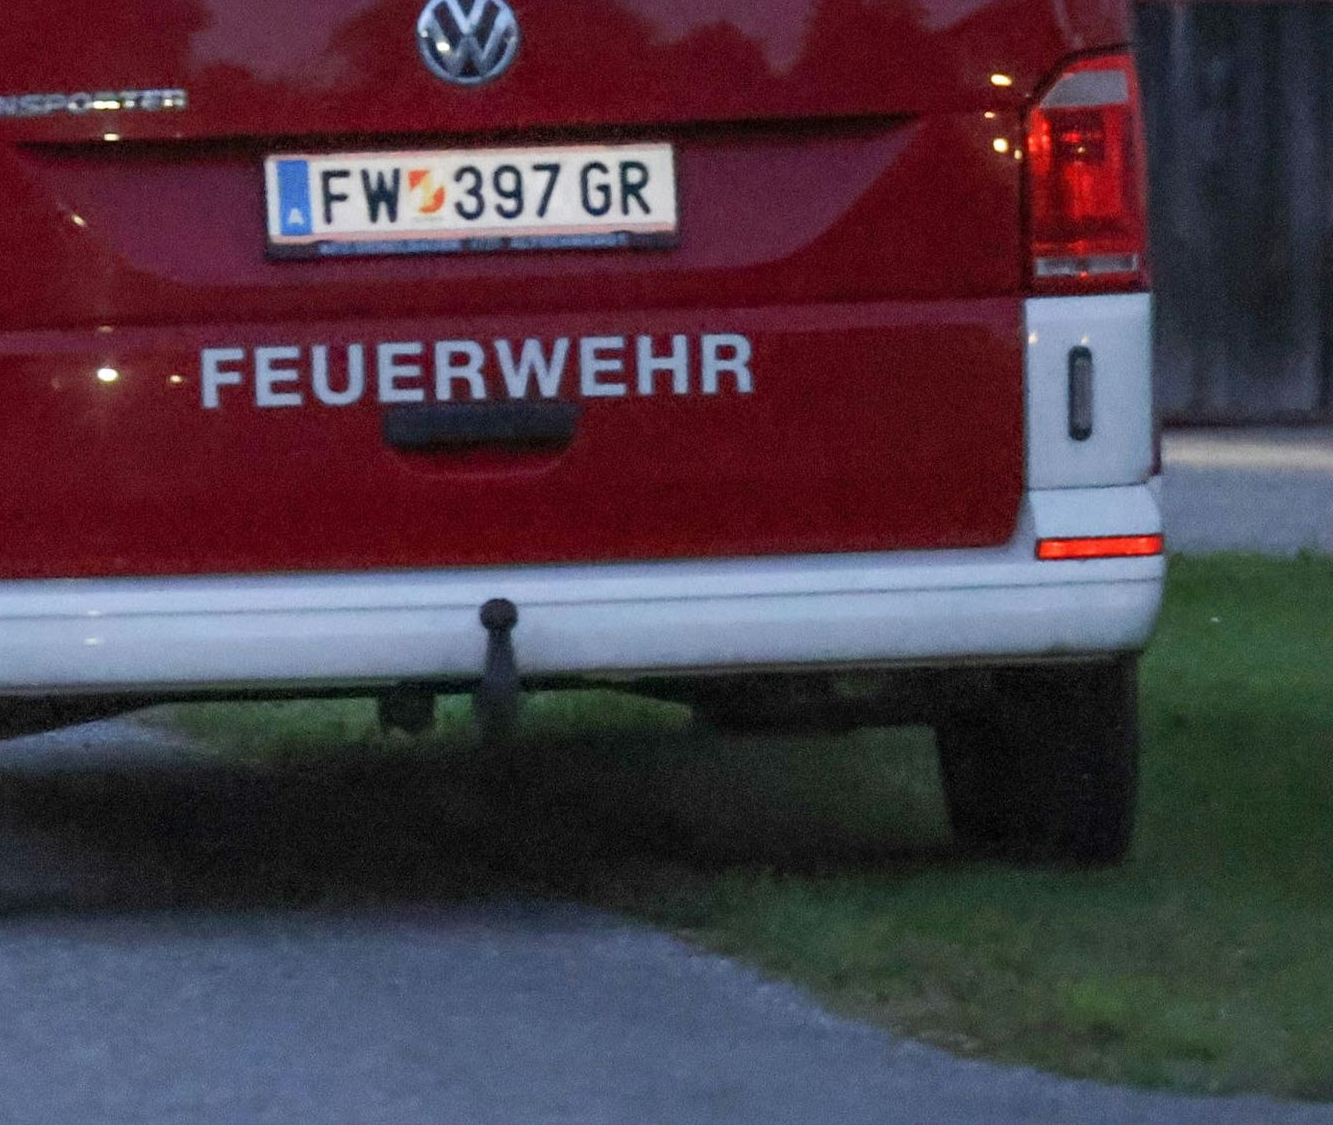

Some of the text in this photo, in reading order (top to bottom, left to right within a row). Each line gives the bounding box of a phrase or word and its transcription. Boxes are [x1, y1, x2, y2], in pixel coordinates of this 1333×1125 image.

[321, 167, 401, 225] FW
[452, 164, 561, 221] 397
[580, 160, 652, 217] GR
[201, 332, 754, 409] FEUERWEHR
